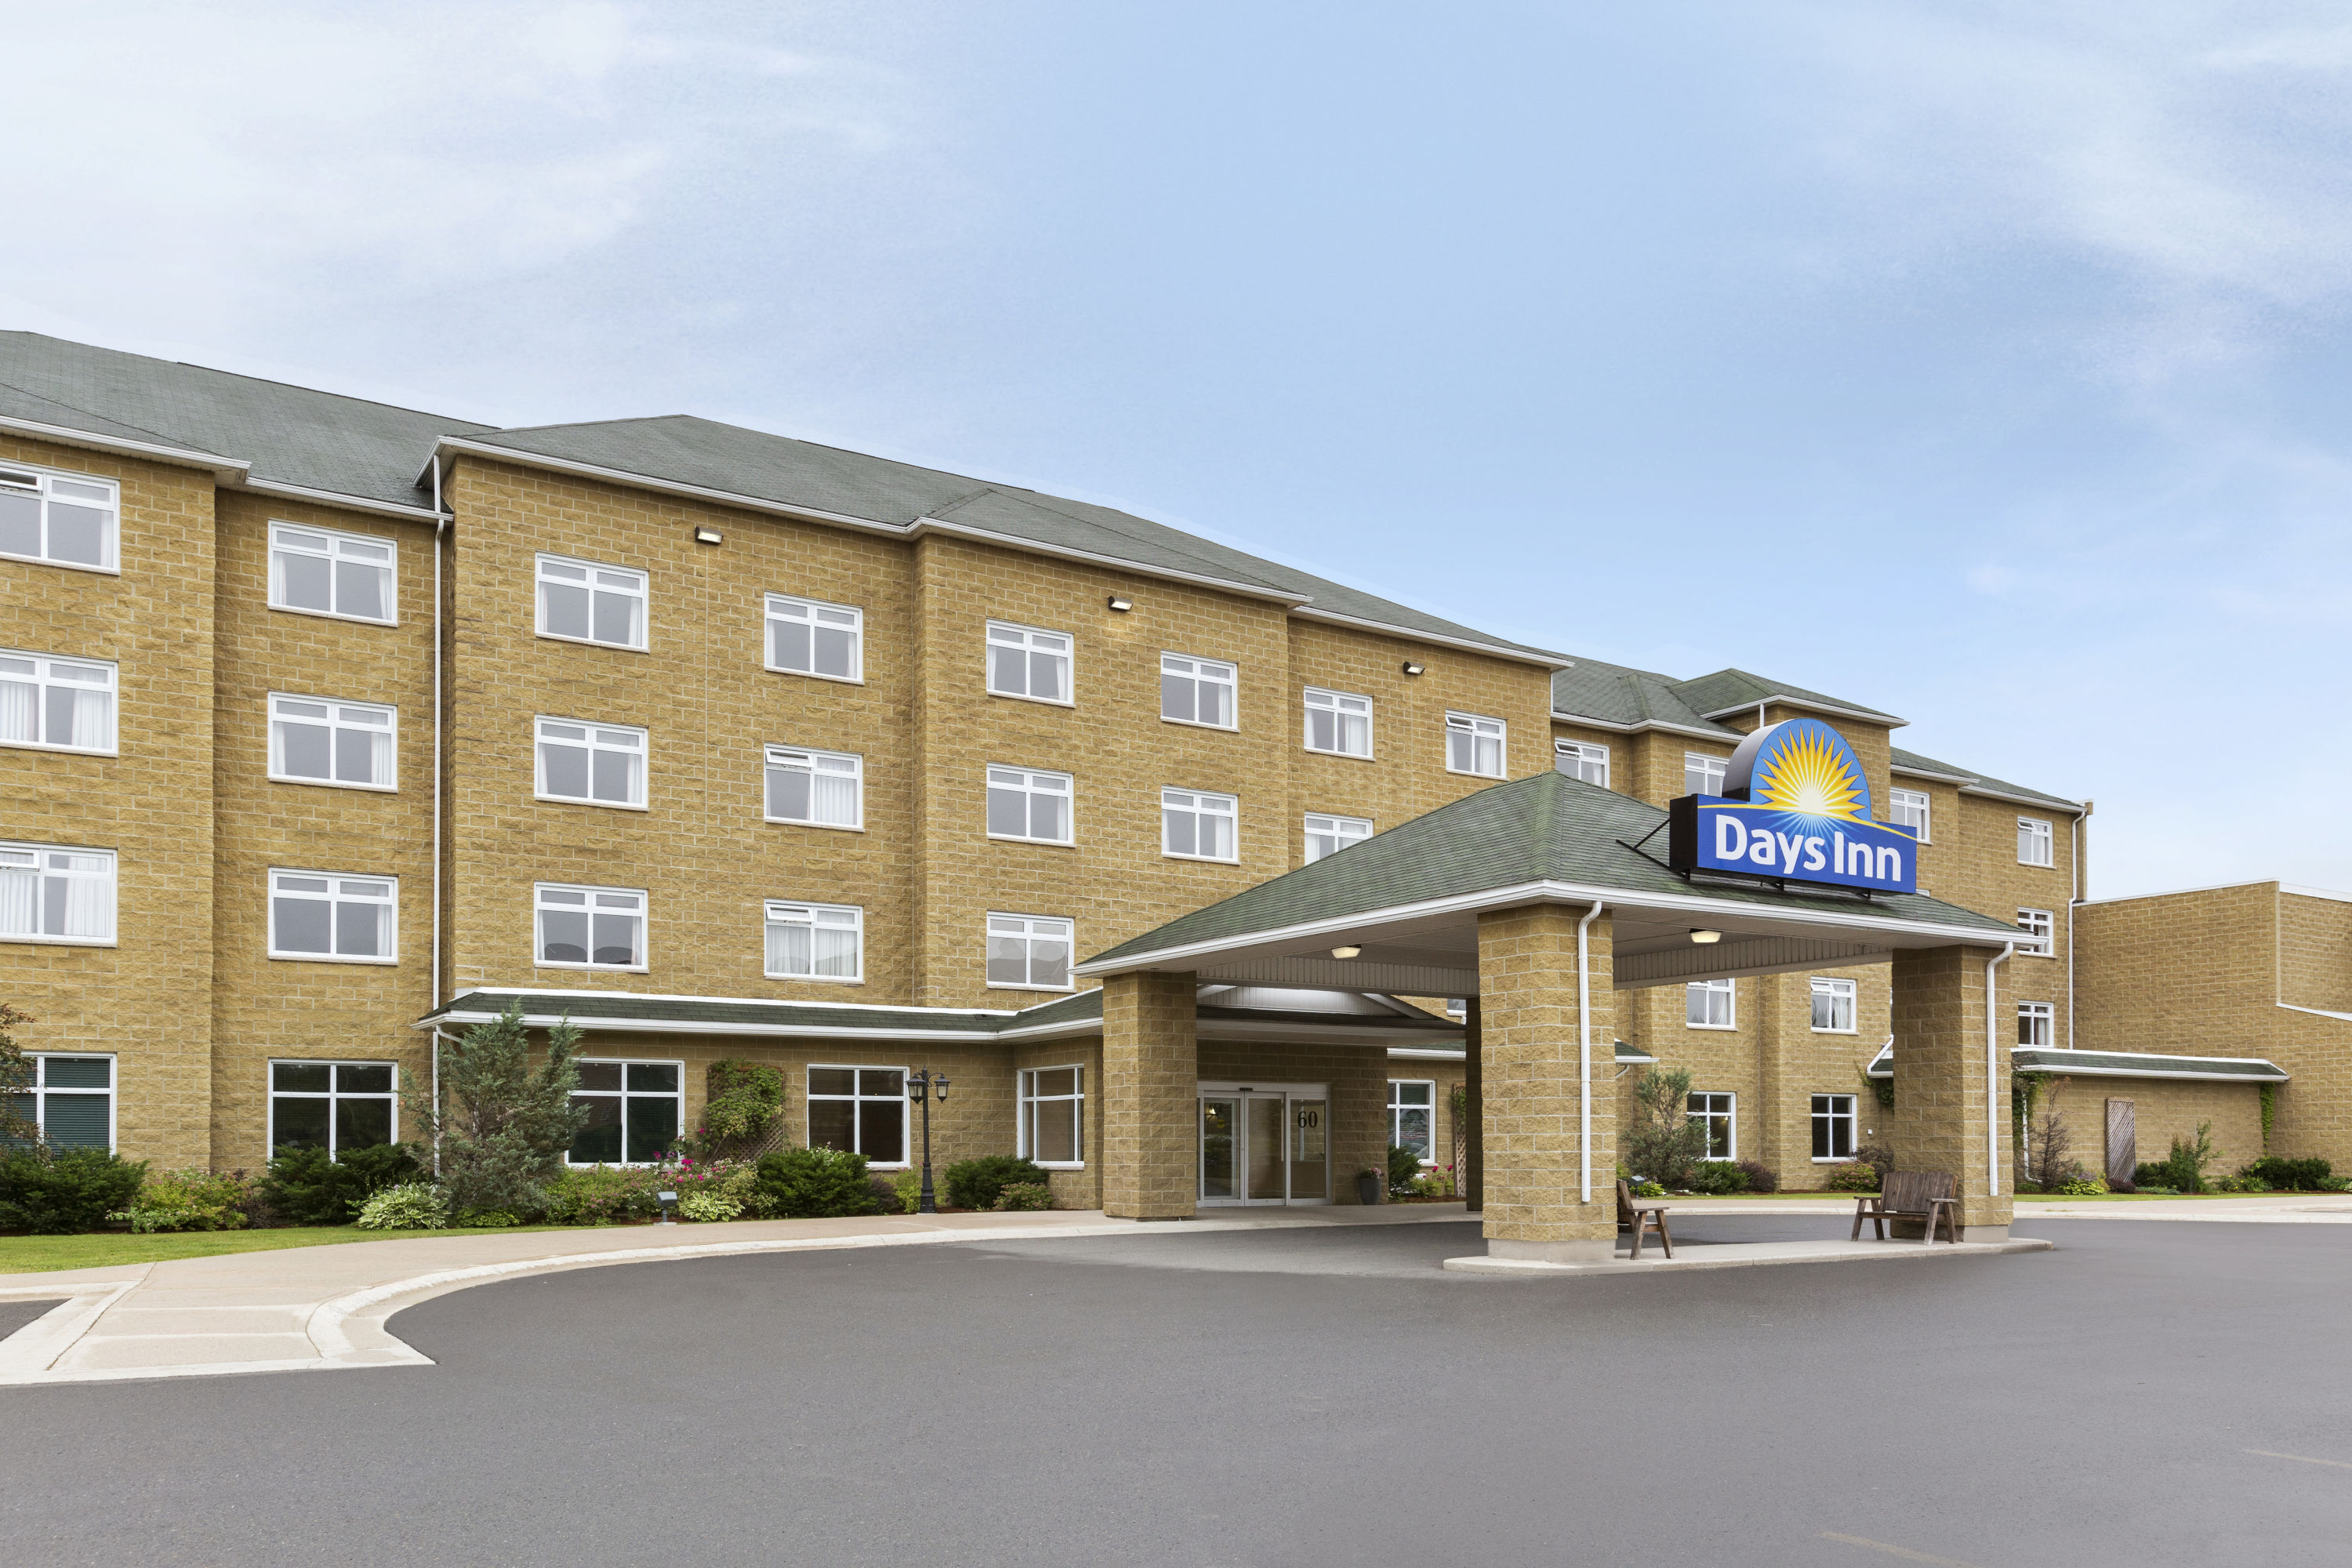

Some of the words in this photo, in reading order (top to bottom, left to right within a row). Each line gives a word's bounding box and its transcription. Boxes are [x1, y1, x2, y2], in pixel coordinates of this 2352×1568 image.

[1715, 814, 1826, 874] Days
[1834, 831, 1901, 882] Inn
[1298, 1110, 1318, 1128] 60
